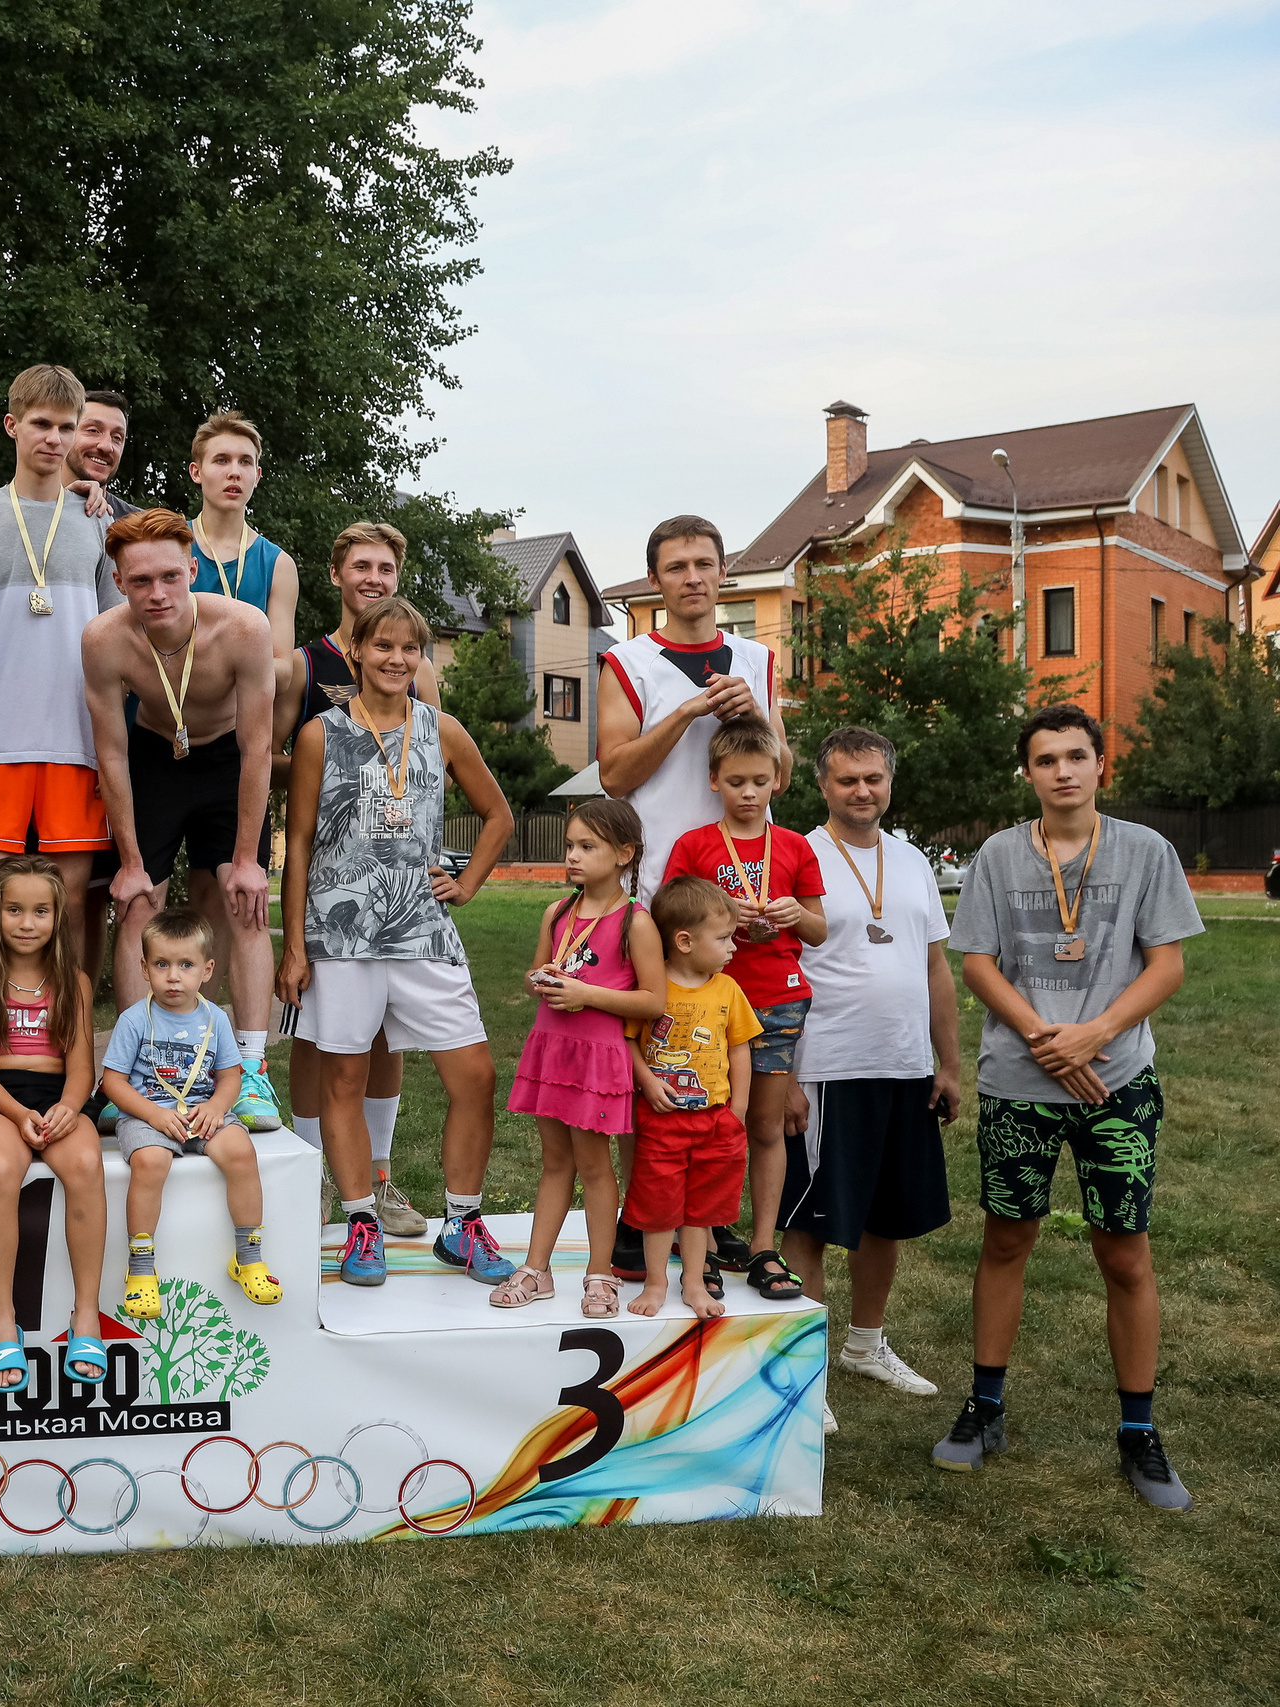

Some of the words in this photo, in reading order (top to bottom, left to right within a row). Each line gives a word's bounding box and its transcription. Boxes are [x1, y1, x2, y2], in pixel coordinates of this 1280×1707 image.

[717, 859, 765, 883] Декий
[726, 872, 763, 891] Заег
[539, 1328, 625, 1483] 3
[98, 1409, 223, 1433] Москва
